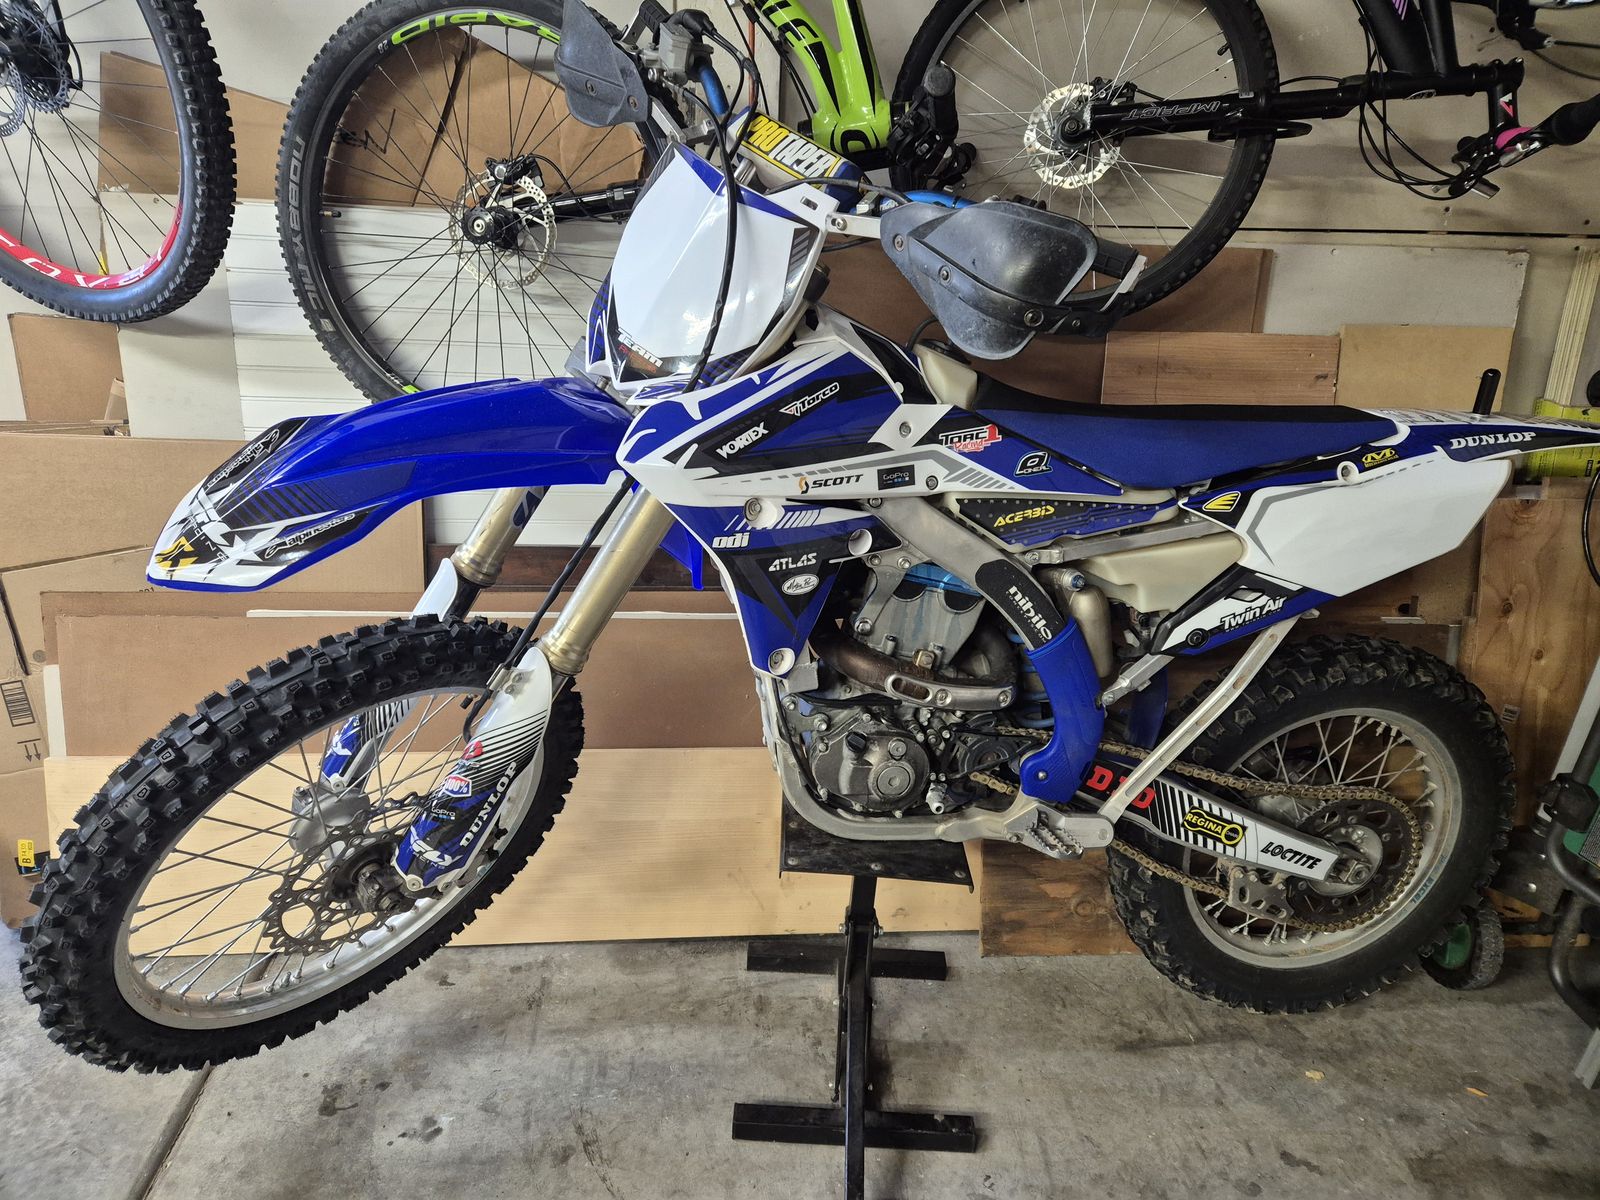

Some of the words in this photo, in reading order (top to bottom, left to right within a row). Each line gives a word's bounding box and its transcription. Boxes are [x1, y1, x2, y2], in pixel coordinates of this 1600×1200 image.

[1121, 100, 1221, 121] IMPACT
[0, 233, 164, 290] OVAL
[715, 421, 770, 459] VORTEX
[1449, 431, 1537, 450] DUNLOP
[810, 473, 864, 489] SCOTT
[882, 471, 910, 481] GoPro
[711, 531, 751, 549] odi
[768, 552, 818, 572] ATLAS
[1008, 585, 1053, 640] nihilo
[1221, 606, 1261, 631] Twin
[1261, 596, 1288, 615] Air
[444, 777, 469, 794] 100%
[459, 761, 517, 848] DUNLOP
[1185, 811, 1223, 835] REGINA
[1260, 841, 1323, 871] LOCTITE
